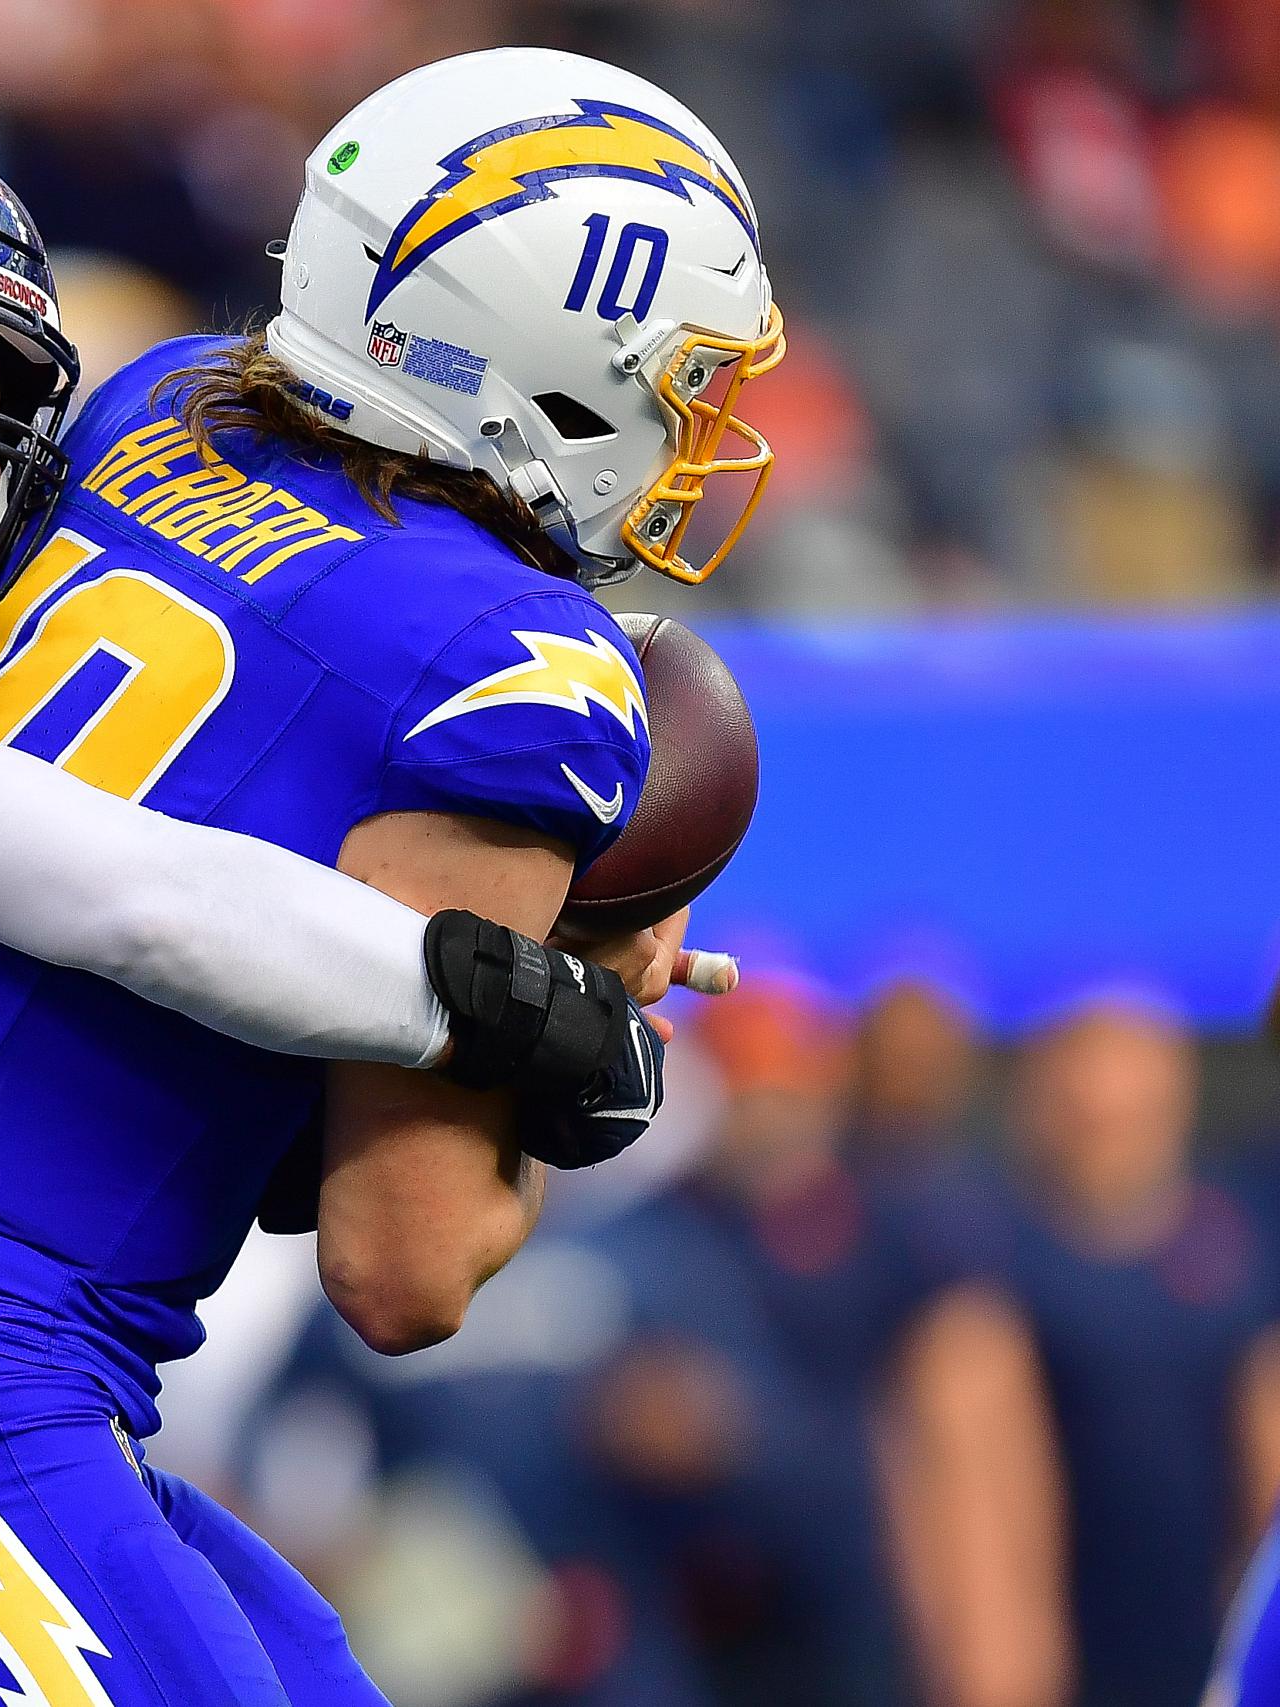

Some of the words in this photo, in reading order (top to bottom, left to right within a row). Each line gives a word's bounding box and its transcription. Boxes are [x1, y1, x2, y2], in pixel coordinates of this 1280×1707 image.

[562, 211, 670, 324] 10
[369, 336, 399, 364] NFL
[80, 416, 367, 587] HERBERT
